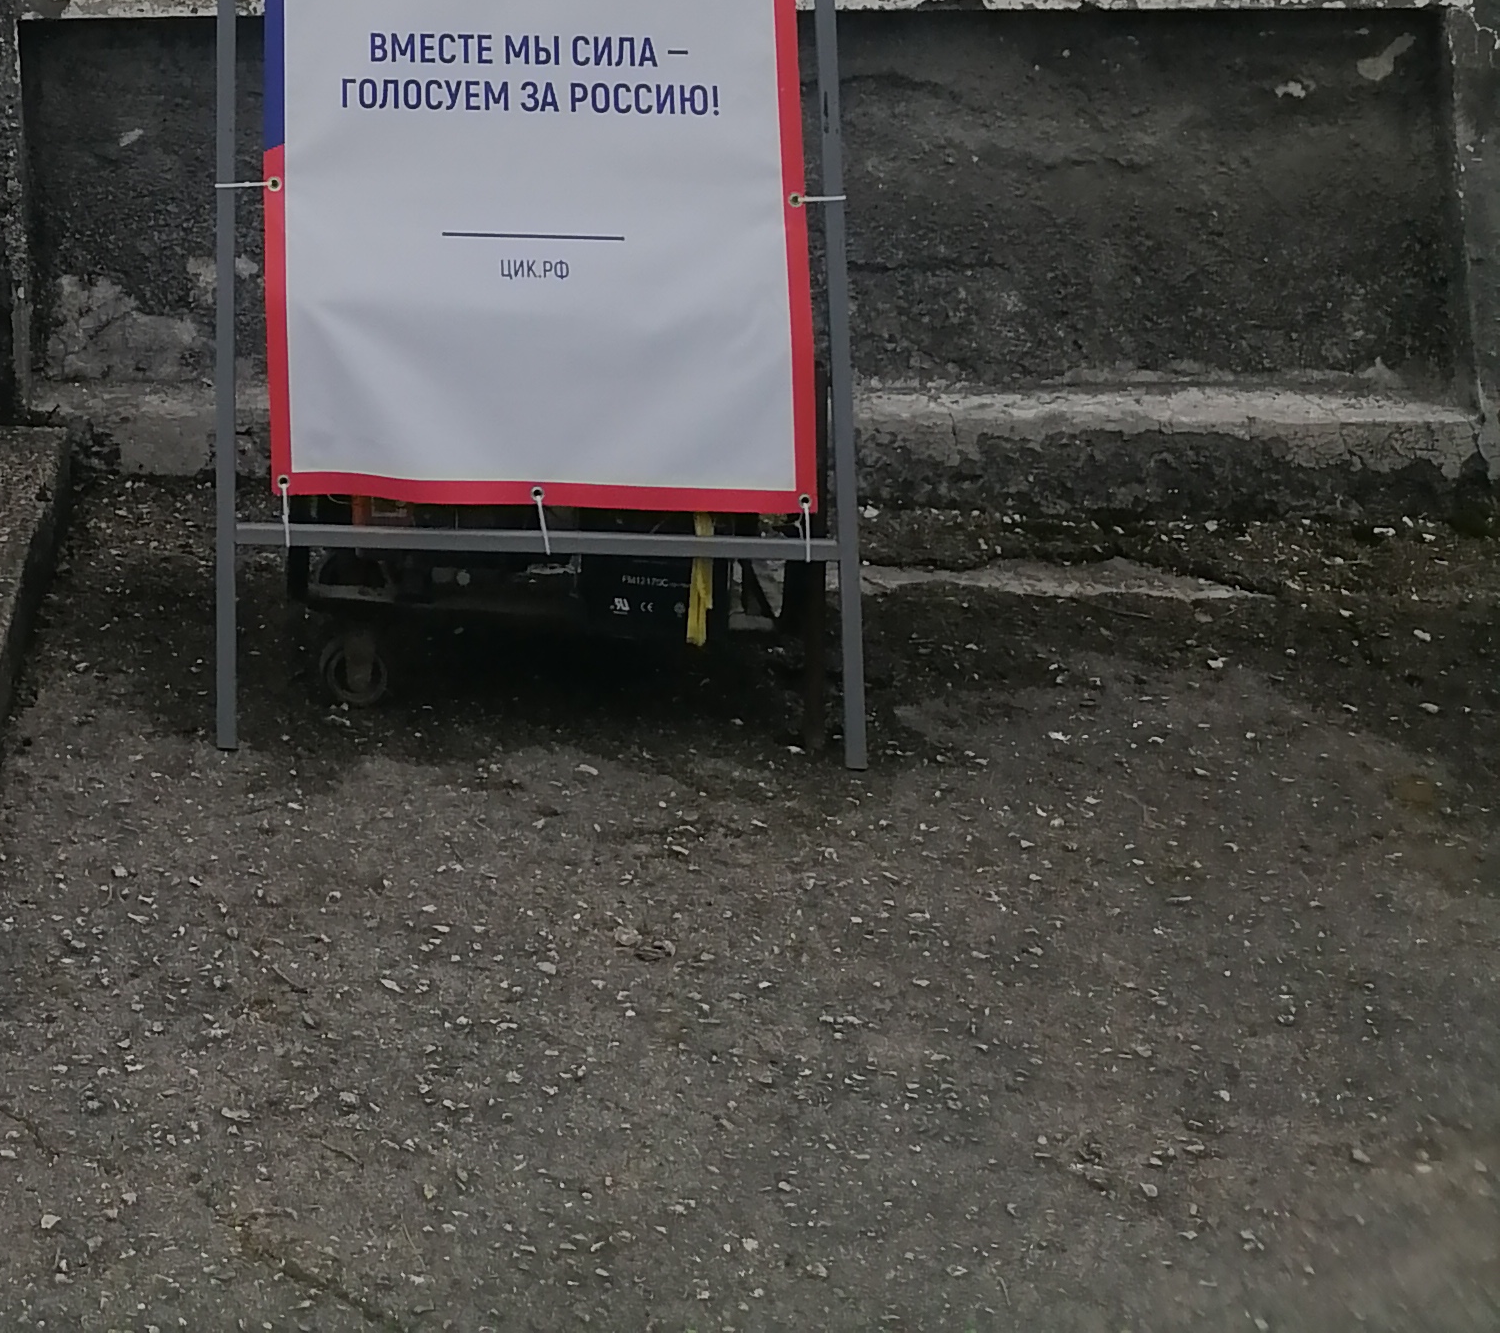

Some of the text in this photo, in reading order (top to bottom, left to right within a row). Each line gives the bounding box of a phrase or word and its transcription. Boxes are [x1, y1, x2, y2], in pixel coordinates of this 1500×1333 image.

[369, 32, 493, 65] ВМЕСТЕ
[504, 35, 561, 66] МЫ
[571, 36, 659, 68] СИЛА
[340, 78, 721, 116] ГОЛОСУЕМ ЗА РОССИЮ!
[499, 259, 570, 281] ЦИК.РФ
